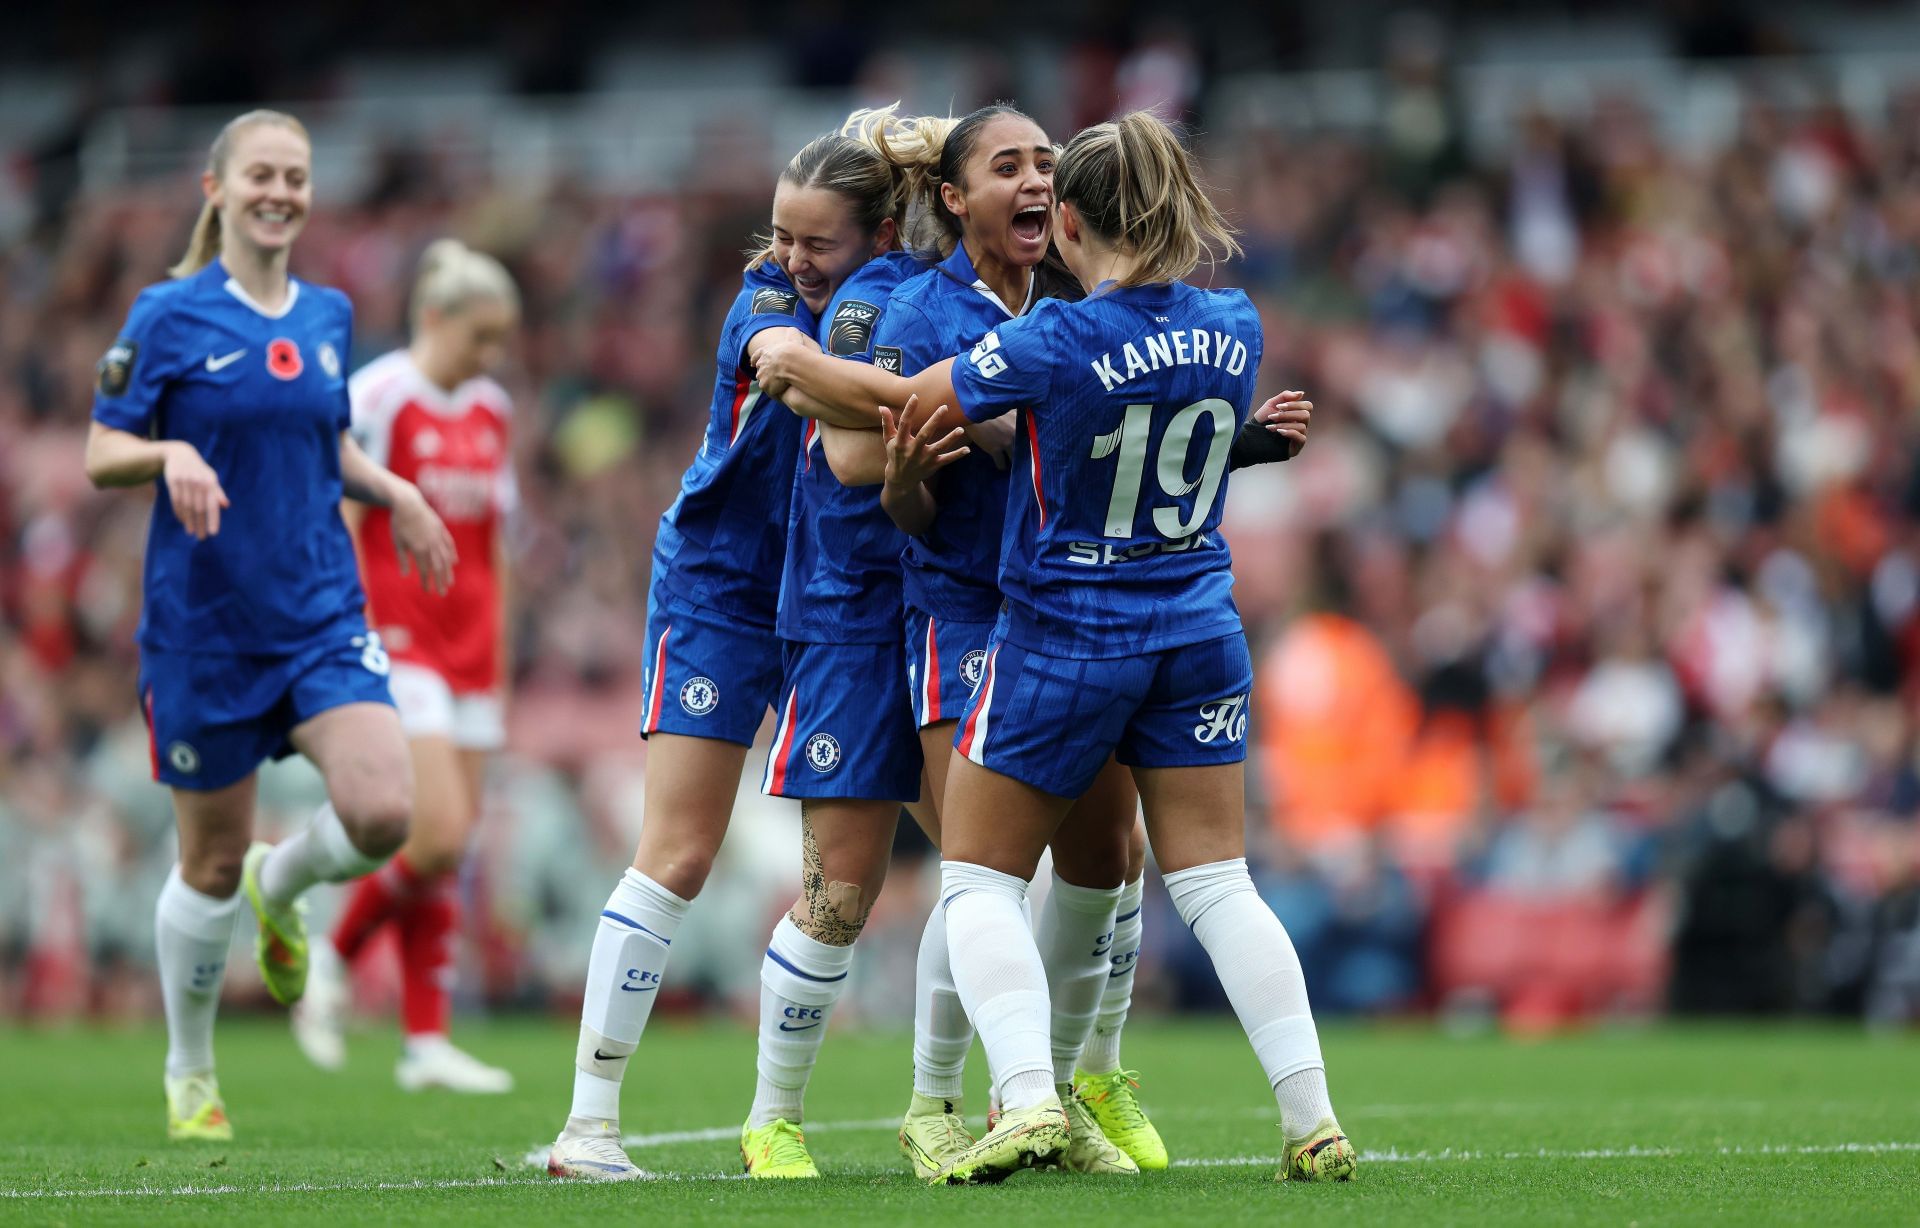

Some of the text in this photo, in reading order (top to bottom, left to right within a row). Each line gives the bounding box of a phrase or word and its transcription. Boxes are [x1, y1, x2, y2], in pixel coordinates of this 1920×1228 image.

[836, 307, 874, 320] WSL
[1091, 328, 1247, 392] KANERYD
[1090, 398, 1237, 539] 19
[688, 678, 713, 688] CHELSEA
[1194, 693, 1247, 743] Flo
[812, 734, 835, 745] CHELSEA
[1095, 931, 1114, 945] CF
[627, 968, 660, 984] CFC
[784, 1006, 822, 1020] CFC
